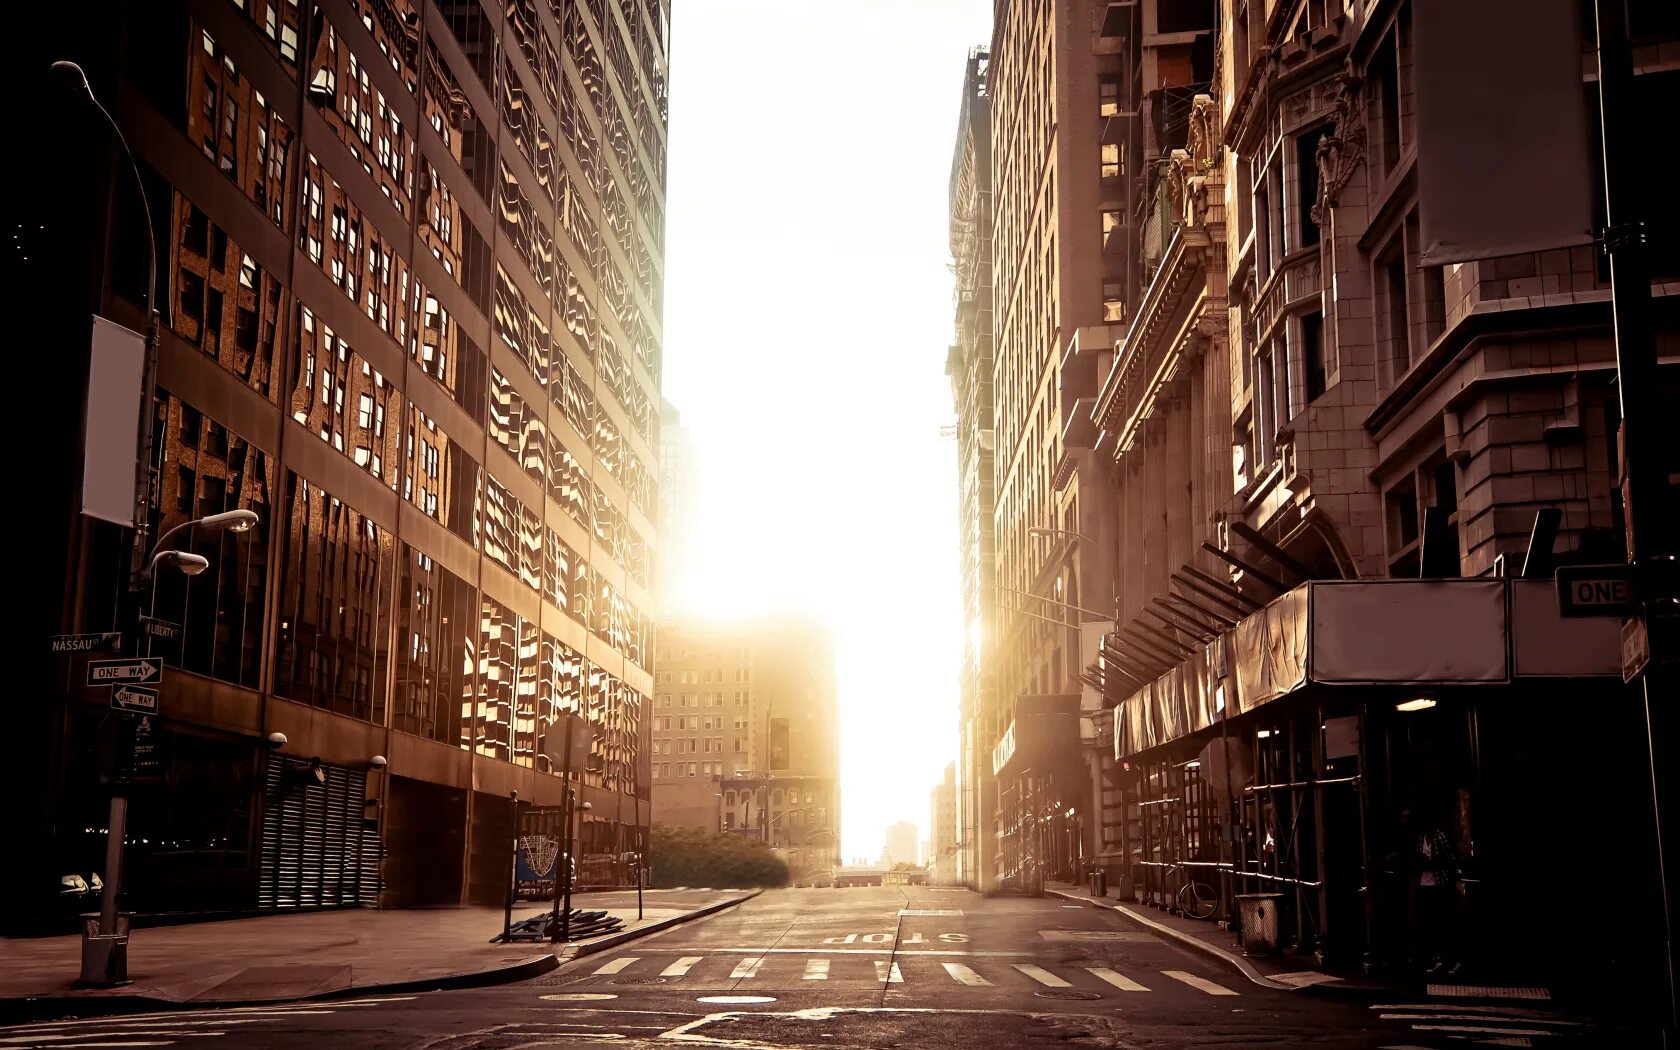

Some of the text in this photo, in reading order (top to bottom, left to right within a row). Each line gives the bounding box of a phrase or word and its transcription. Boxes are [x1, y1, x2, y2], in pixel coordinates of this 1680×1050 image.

[1578, 582, 1627, 602] ONE
[151, 624, 174, 638] LIBERTY
[52, 638, 100, 652] NASSAU ST
[98, 667, 150, 677] ONE WAY
[119, 692, 152, 705] ONE WAY
[820, 932, 971, 945] STOP
